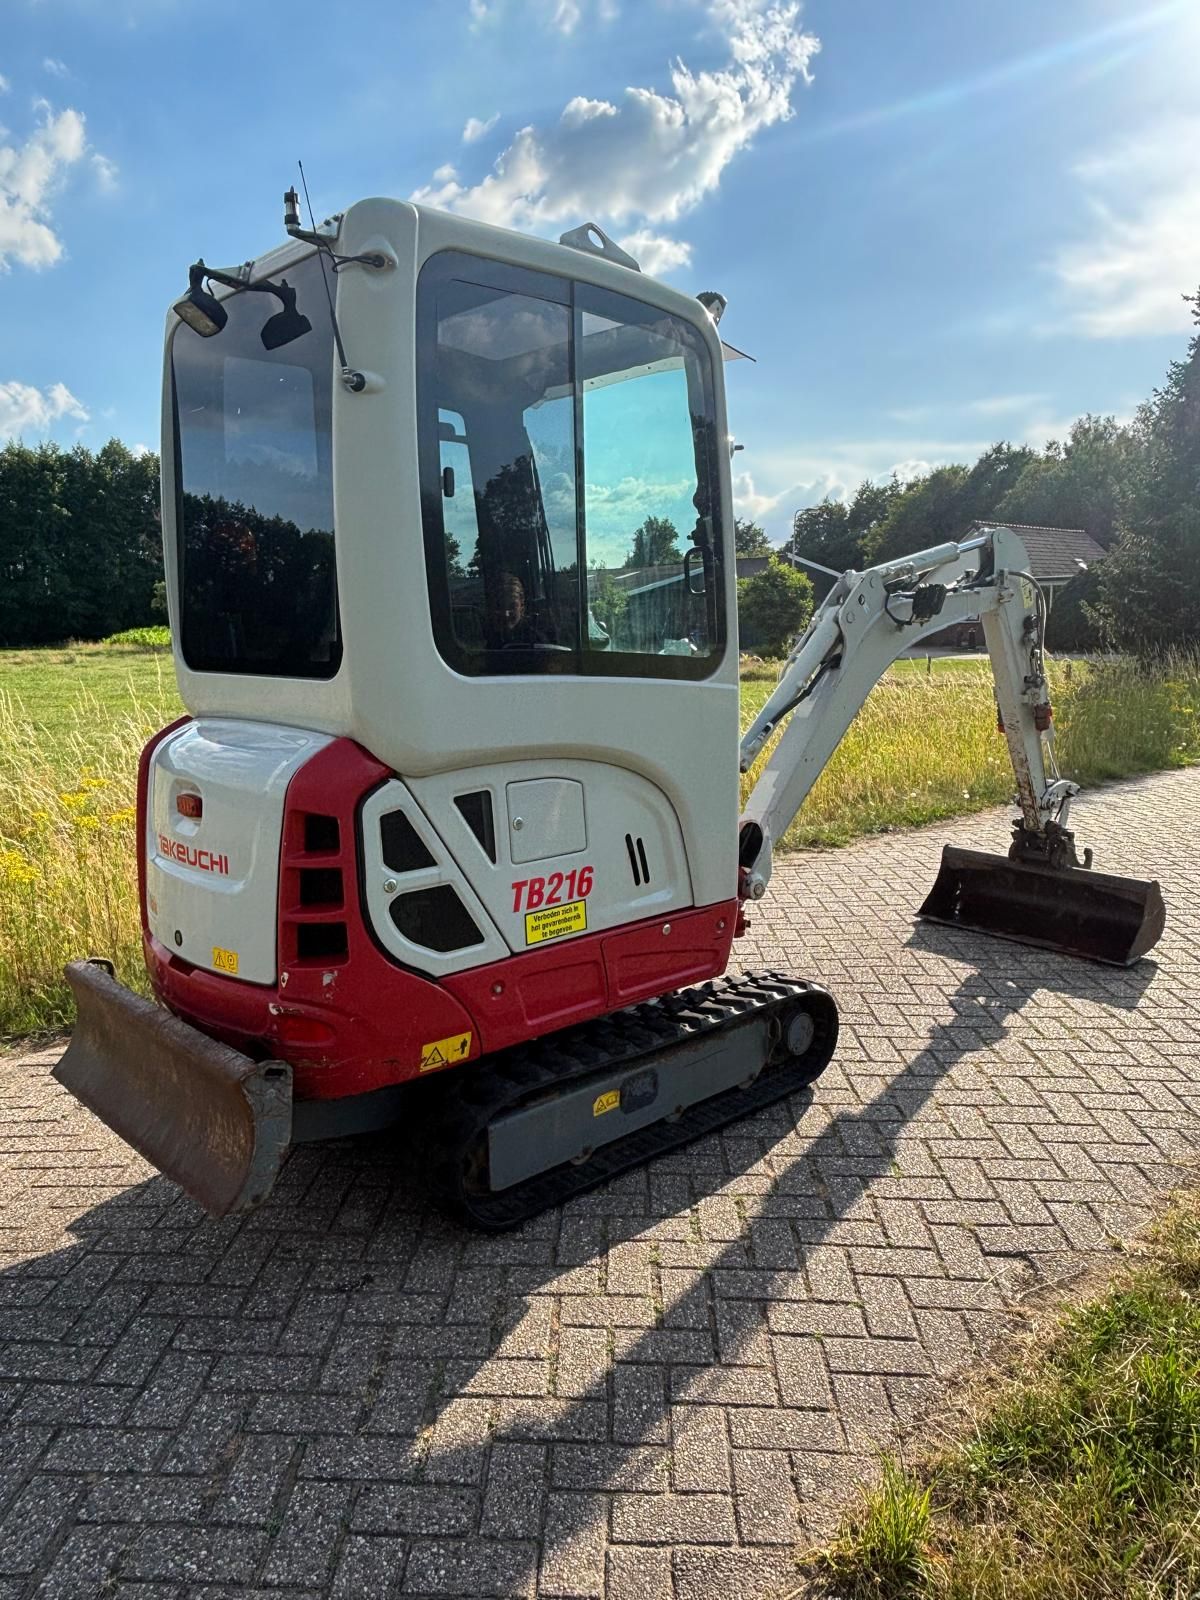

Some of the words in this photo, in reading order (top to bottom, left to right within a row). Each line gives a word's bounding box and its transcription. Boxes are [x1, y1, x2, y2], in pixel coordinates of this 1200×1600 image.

[512, 866, 594, 913] TB216
[533, 910, 560, 922] Verboden
[549, 925, 573, 937] begeven
